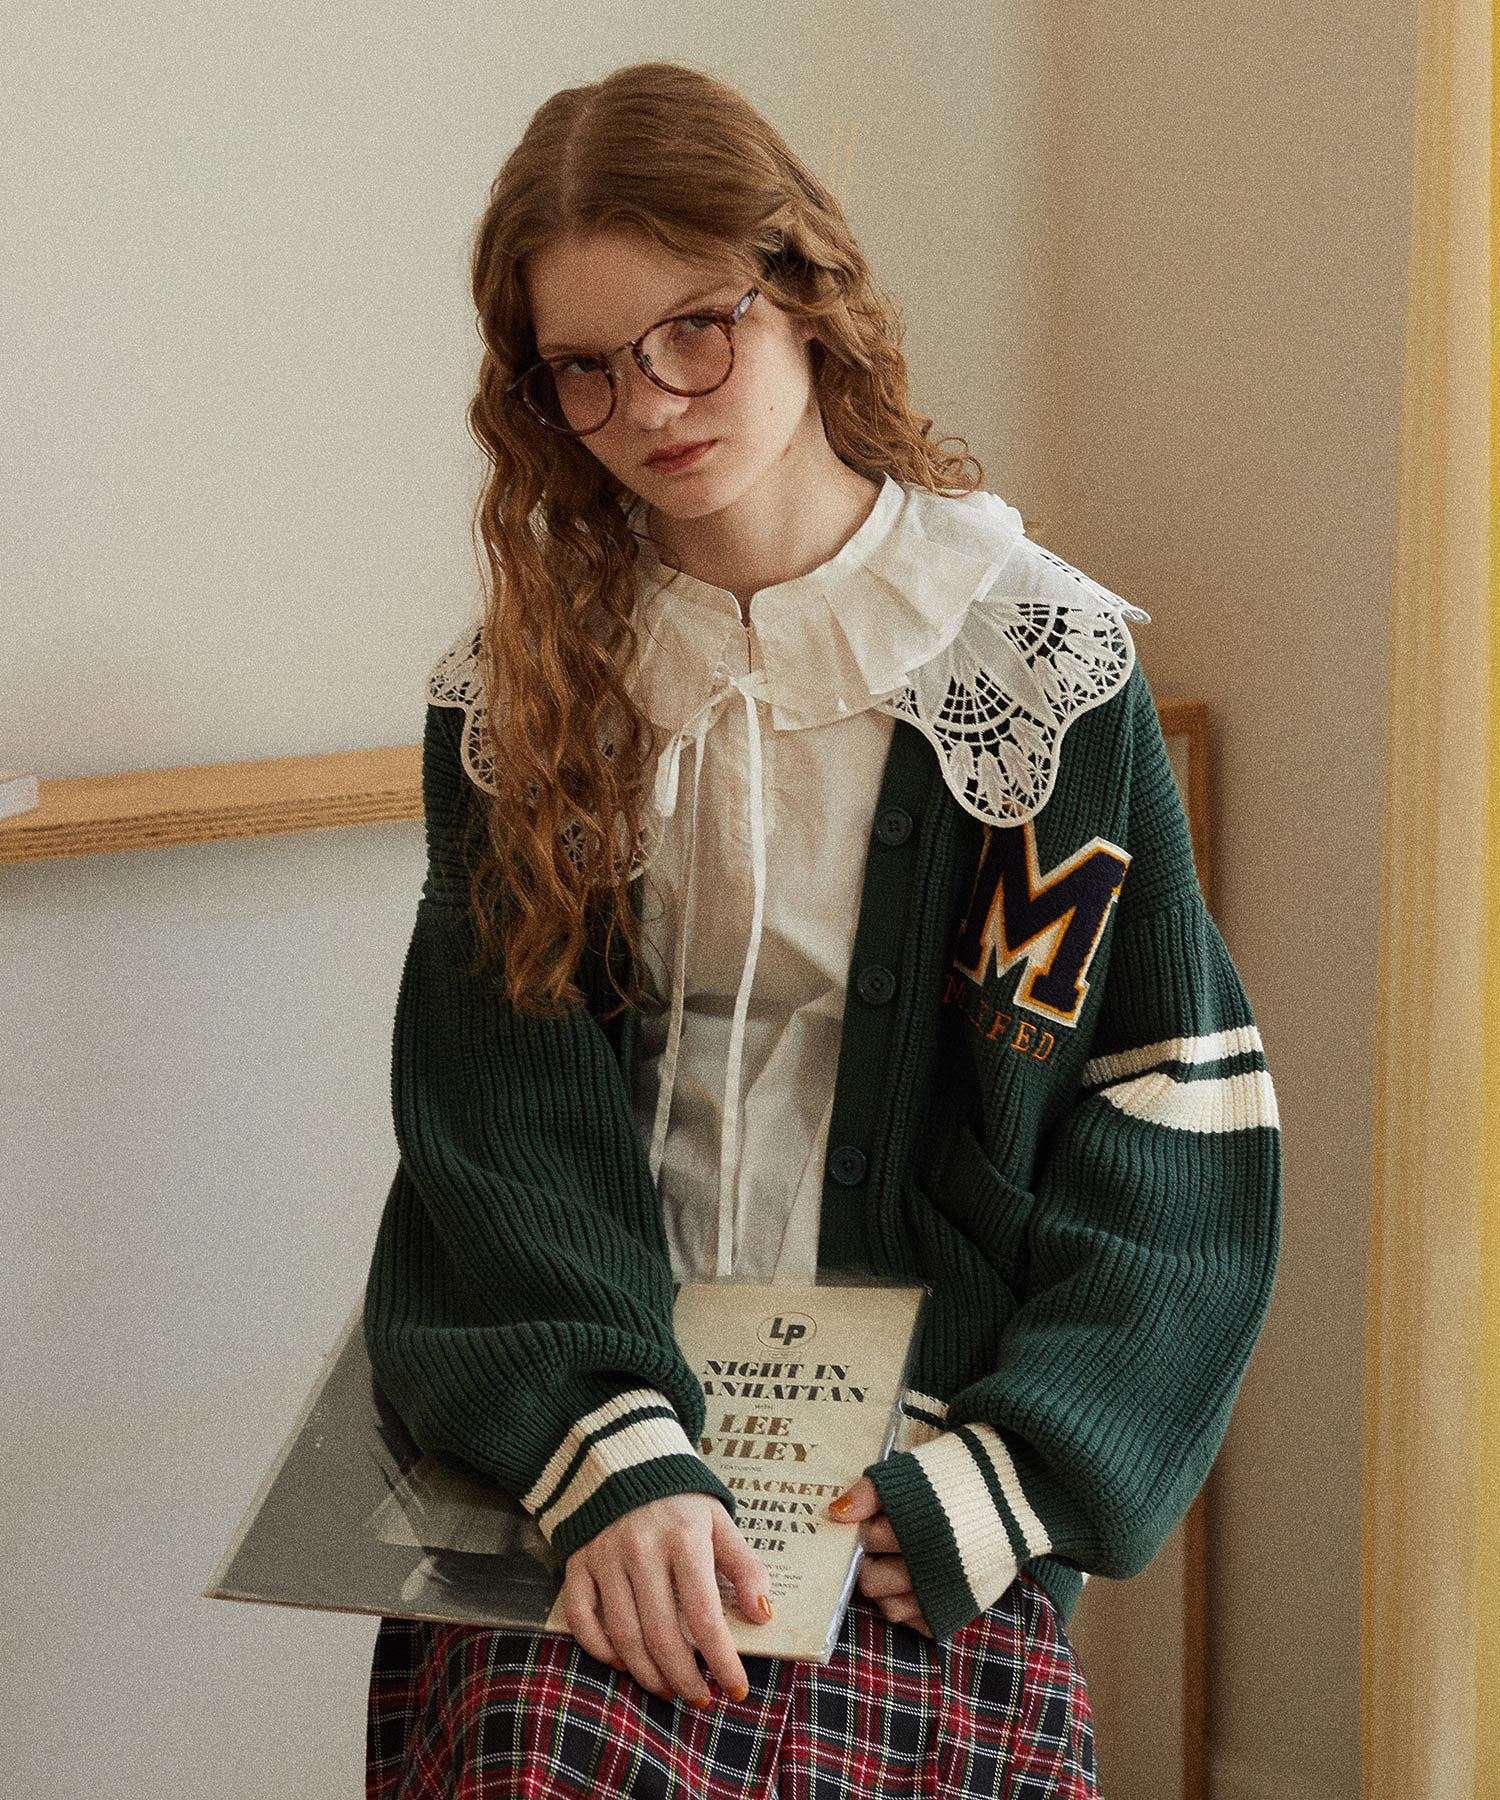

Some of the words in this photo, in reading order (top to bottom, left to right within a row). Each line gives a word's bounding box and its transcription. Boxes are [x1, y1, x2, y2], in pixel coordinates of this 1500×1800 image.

[953, 820, 1133, 1028] M
[703, 1360, 804, 1378] NIGHT
[814, 1364, 850, 1380] IN
[703, 1381, 868, 1403] ANHATTAN
[719, 1414, 793, 1436] LEE
[727, 1477, 846, 1498] HACKETT
[736, 1498, 817, 1516] SHKIN
[734, 1516, 821, 1535] EEMAN
